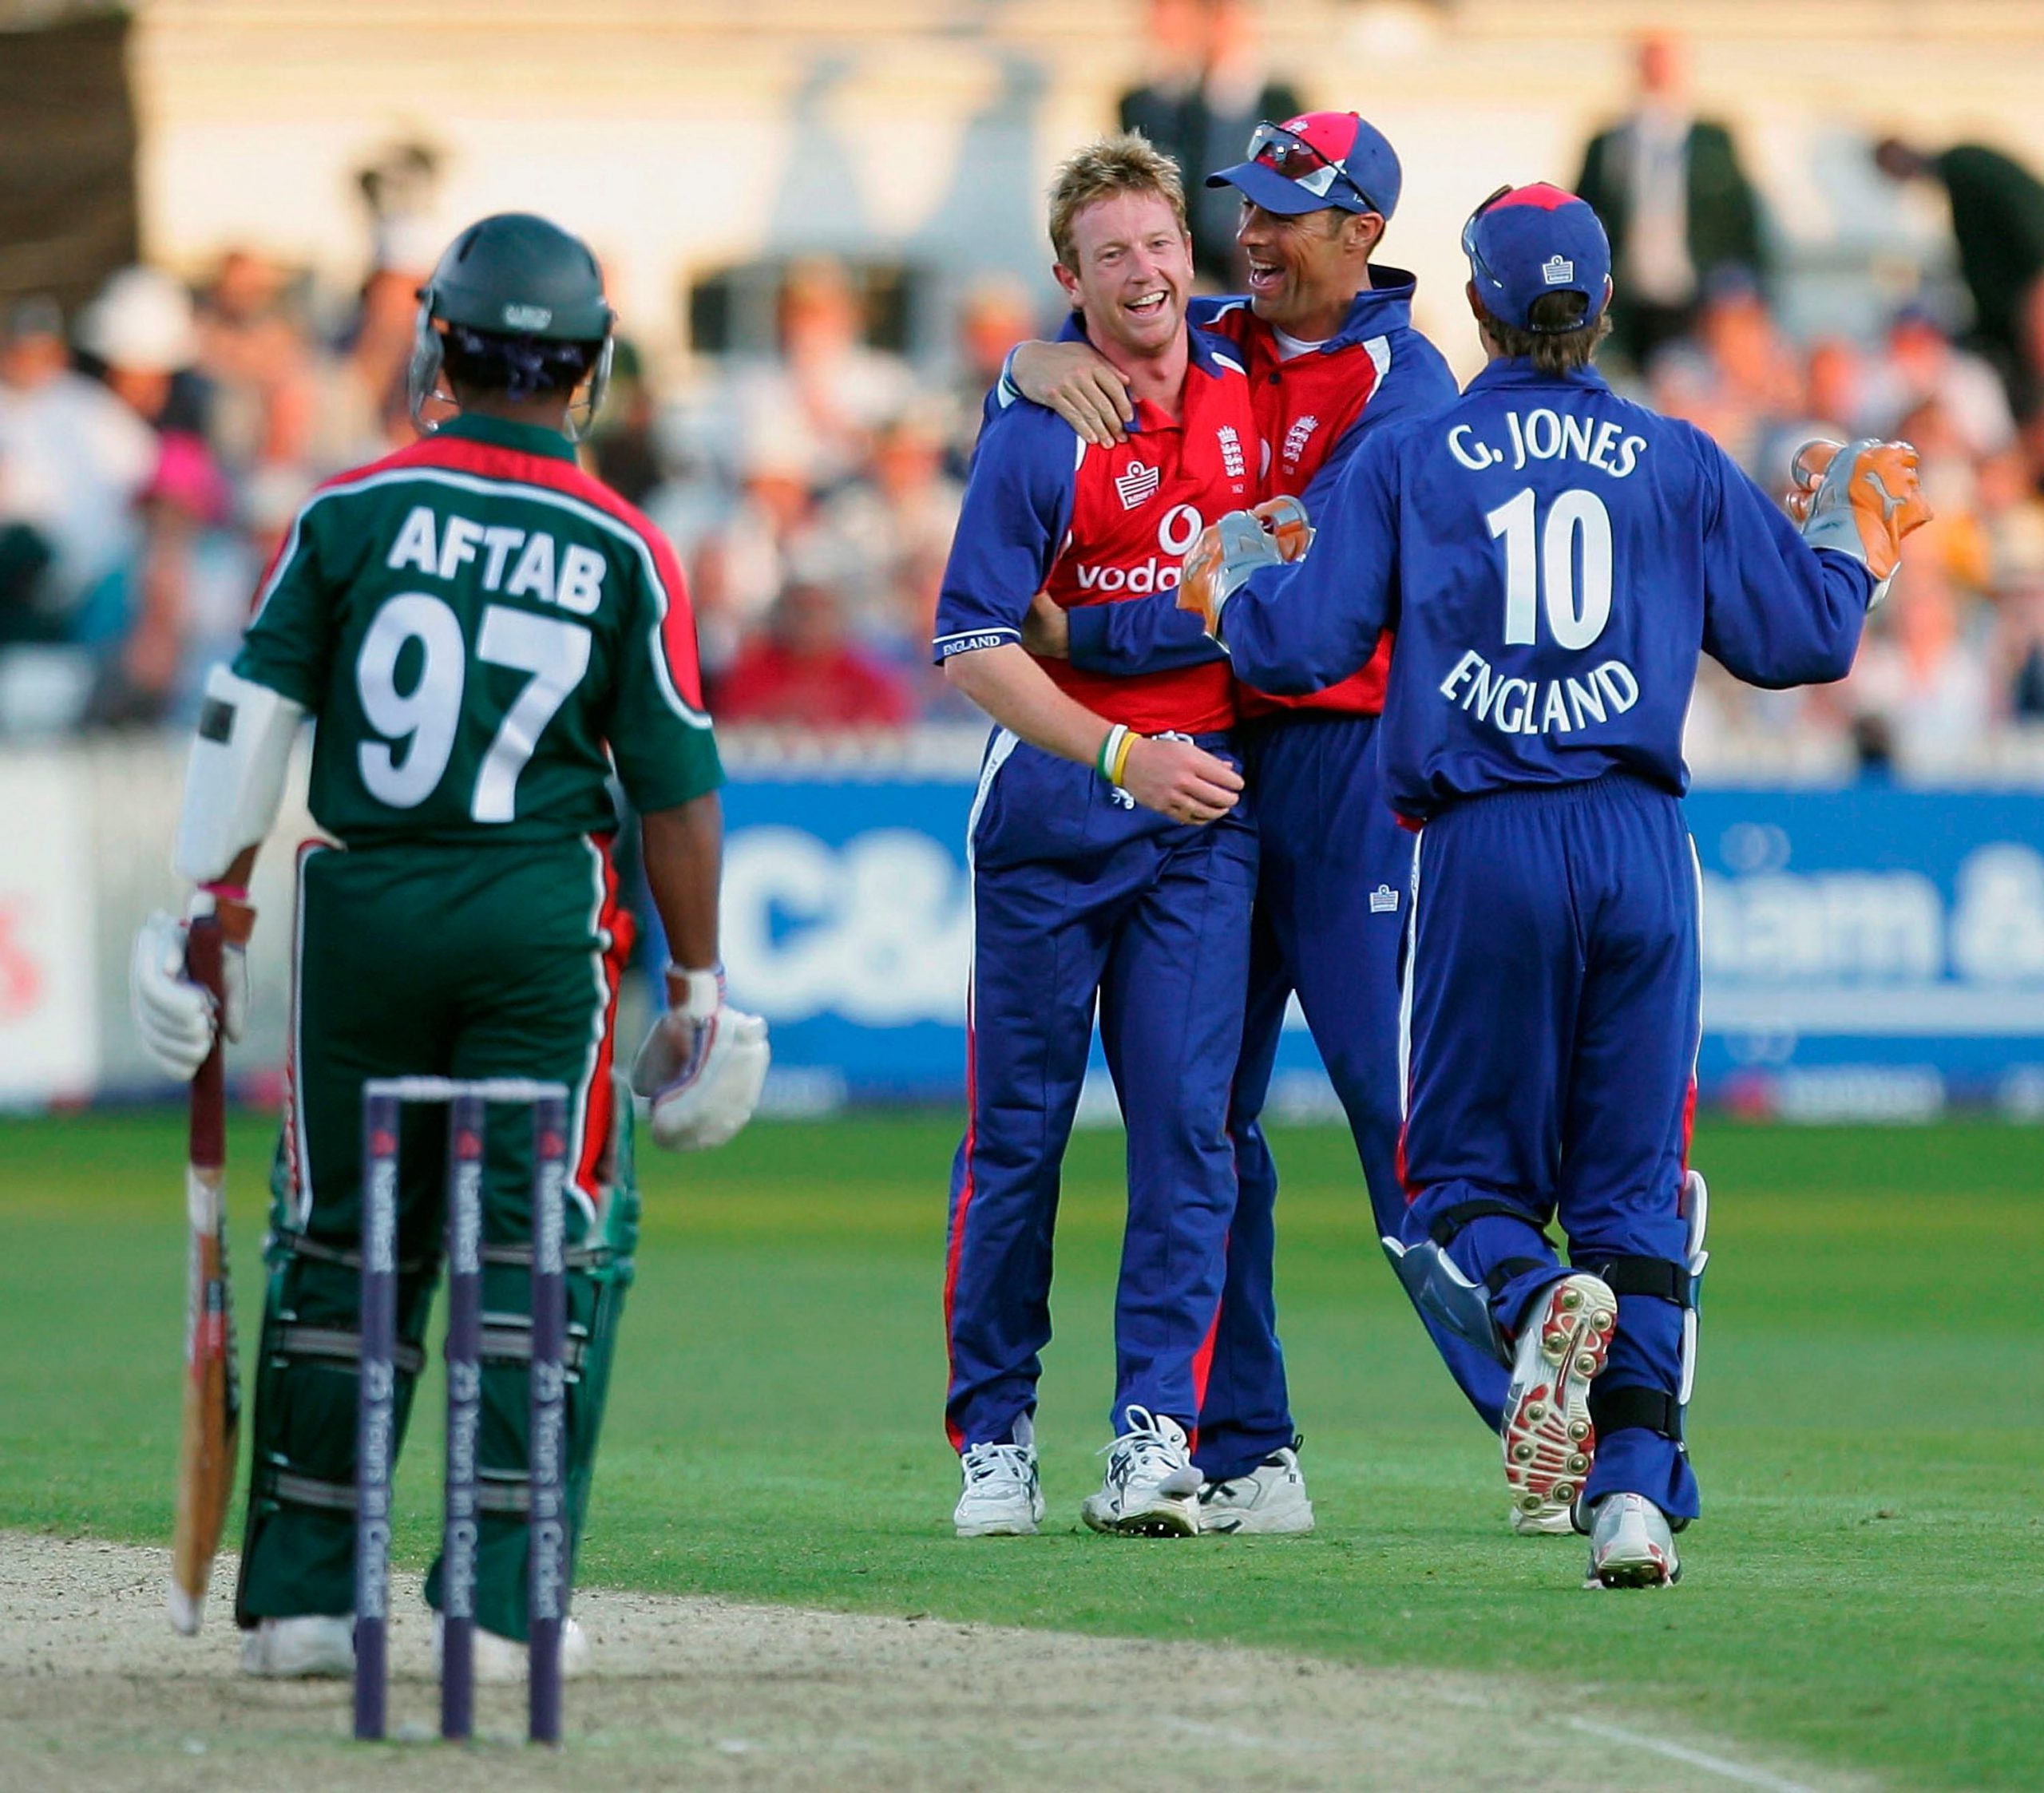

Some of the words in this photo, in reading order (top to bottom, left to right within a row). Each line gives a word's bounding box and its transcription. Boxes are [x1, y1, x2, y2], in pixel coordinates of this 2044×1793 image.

[1448, 424, 1503, 470] G.
[1505, 408, 1647, 477] JONES
[387, 505, 608, 615] AFTAB
[1487, 487, 1613, 651] 10
[943, 635, 1001, 656] ENGLAND
[1440, 649, 1639, 735] ENGLAND
[356, 591, 592, 823] 97
[372, 1159, 397, 1273] NatWest
[457, 1161, 481, 1274] NatWest
[540, 1162, 564, 1274] NatWest
[362, 1403, 392, 1485] Years
[450, 1403, 479, 1485] Years
[534, 1403, 564, 1486] Years
[363, 1488, 390, 1518] in
[450, 1488, 476, 1518] in
[536, 1488, 562, 1518] in
[361, 1518, 391, 1619] Cricket
[449, 1518, 478, 1619] Cricket
[536, 1518, 564, 1619] Cricket
